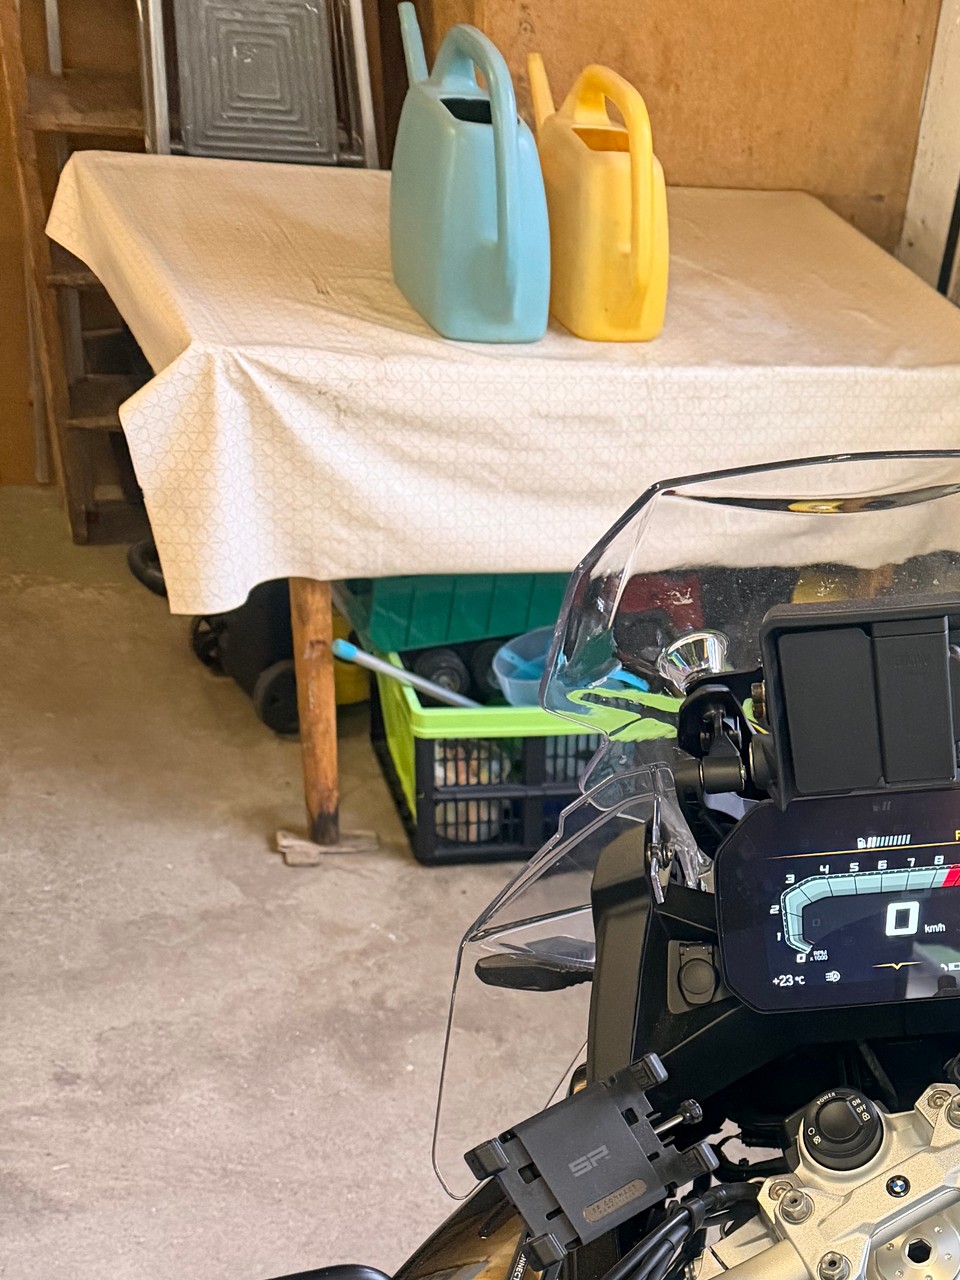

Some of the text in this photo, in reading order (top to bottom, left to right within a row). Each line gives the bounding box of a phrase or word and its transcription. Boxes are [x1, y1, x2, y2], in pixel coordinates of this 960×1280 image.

[819, 864, 830, 874] 4
[849, 862, 860, 872] 5
[877, 860, 888, 870] 6
[907, 857, 916, 868] 7
[934, 855, 945, 865] 8
[785, 874, 796, 884] 3
[769, 905, 780, 915] 2
[885, 900, 946, 937] 0 km/h
[776, 932, 782, 941] 1
[796, 953, 806, 963] 0
[772, 974, 794, 987] +23
[816, 1091, 837, 1106] POWER
[851, 1097, 862, 1107] ON
[856, 1103, 867, 1114] OFF
[568, 1144, 611, 1178] SP
